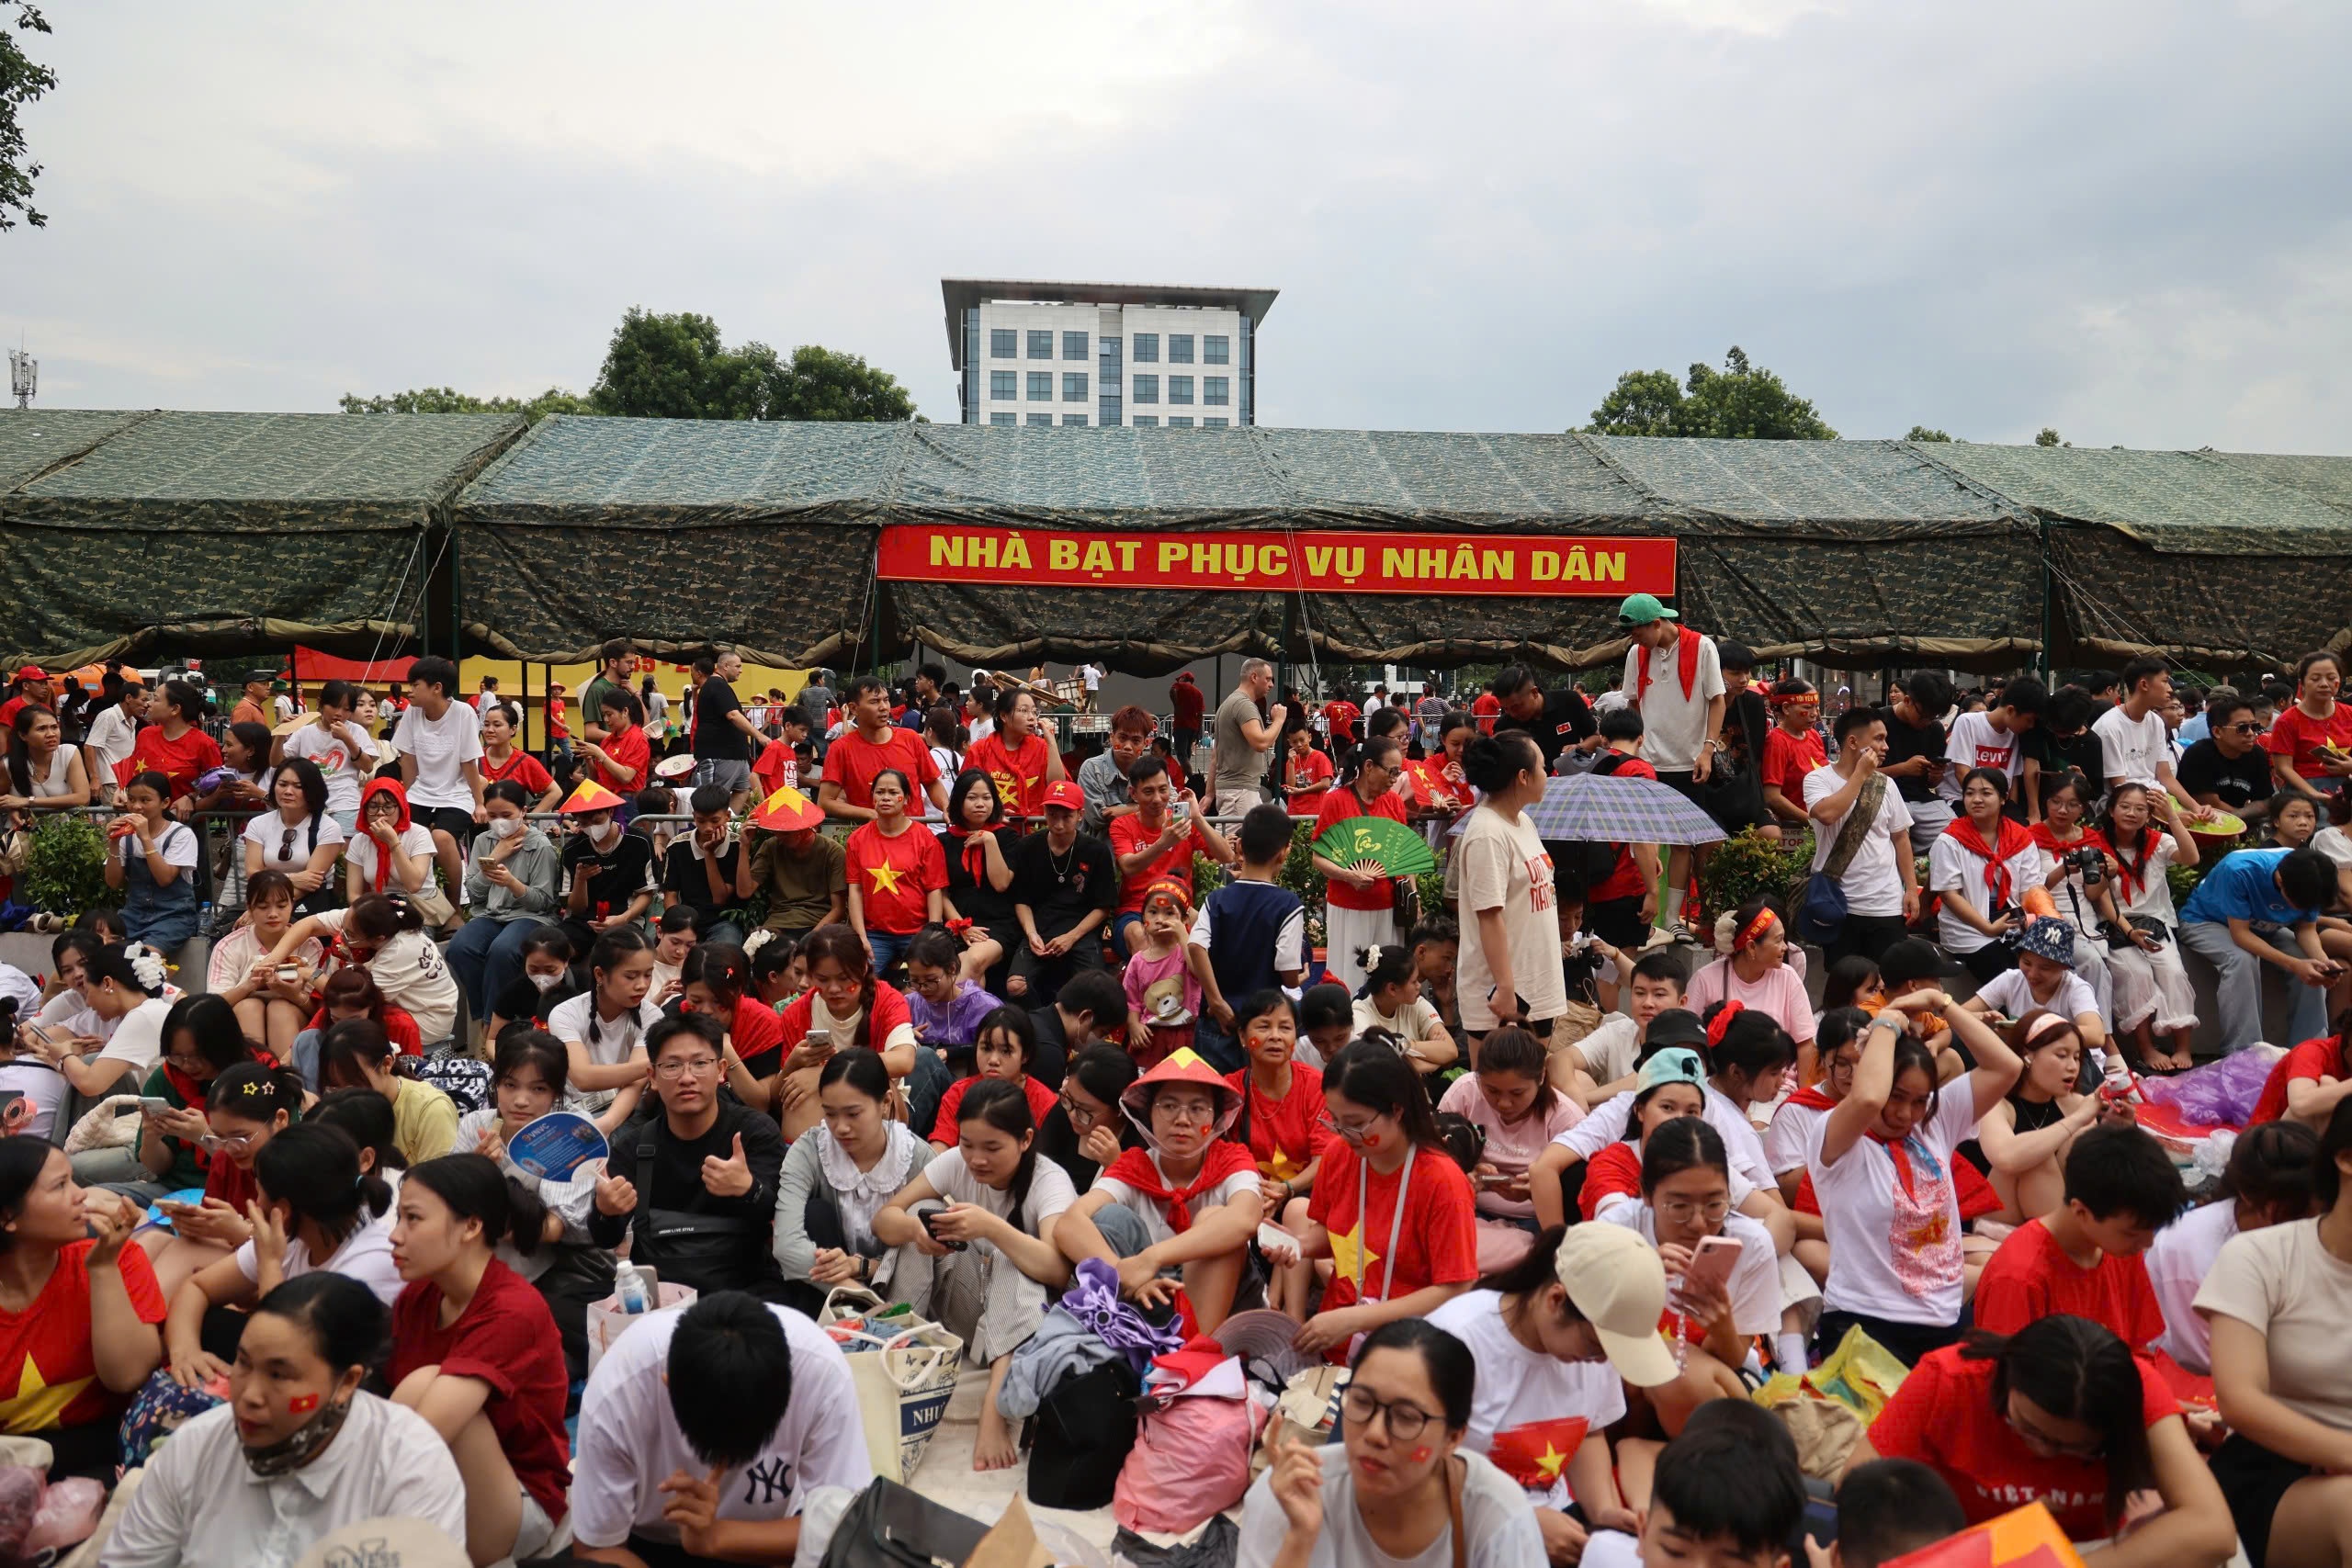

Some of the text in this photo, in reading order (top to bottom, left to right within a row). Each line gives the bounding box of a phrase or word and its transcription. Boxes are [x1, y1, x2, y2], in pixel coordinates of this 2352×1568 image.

[930, 531, 1626, 584] NHÀ BẠT PHỤC VỤ NHÂN DÂN
[633, 656, 656, 673] 45
[1781, 839, 1804, 847] TOP
[2044, 926, 2062, 945] NY
[529, 1122, 550, 1138] VNVC
[744, 1456, 793, 1505] NY
